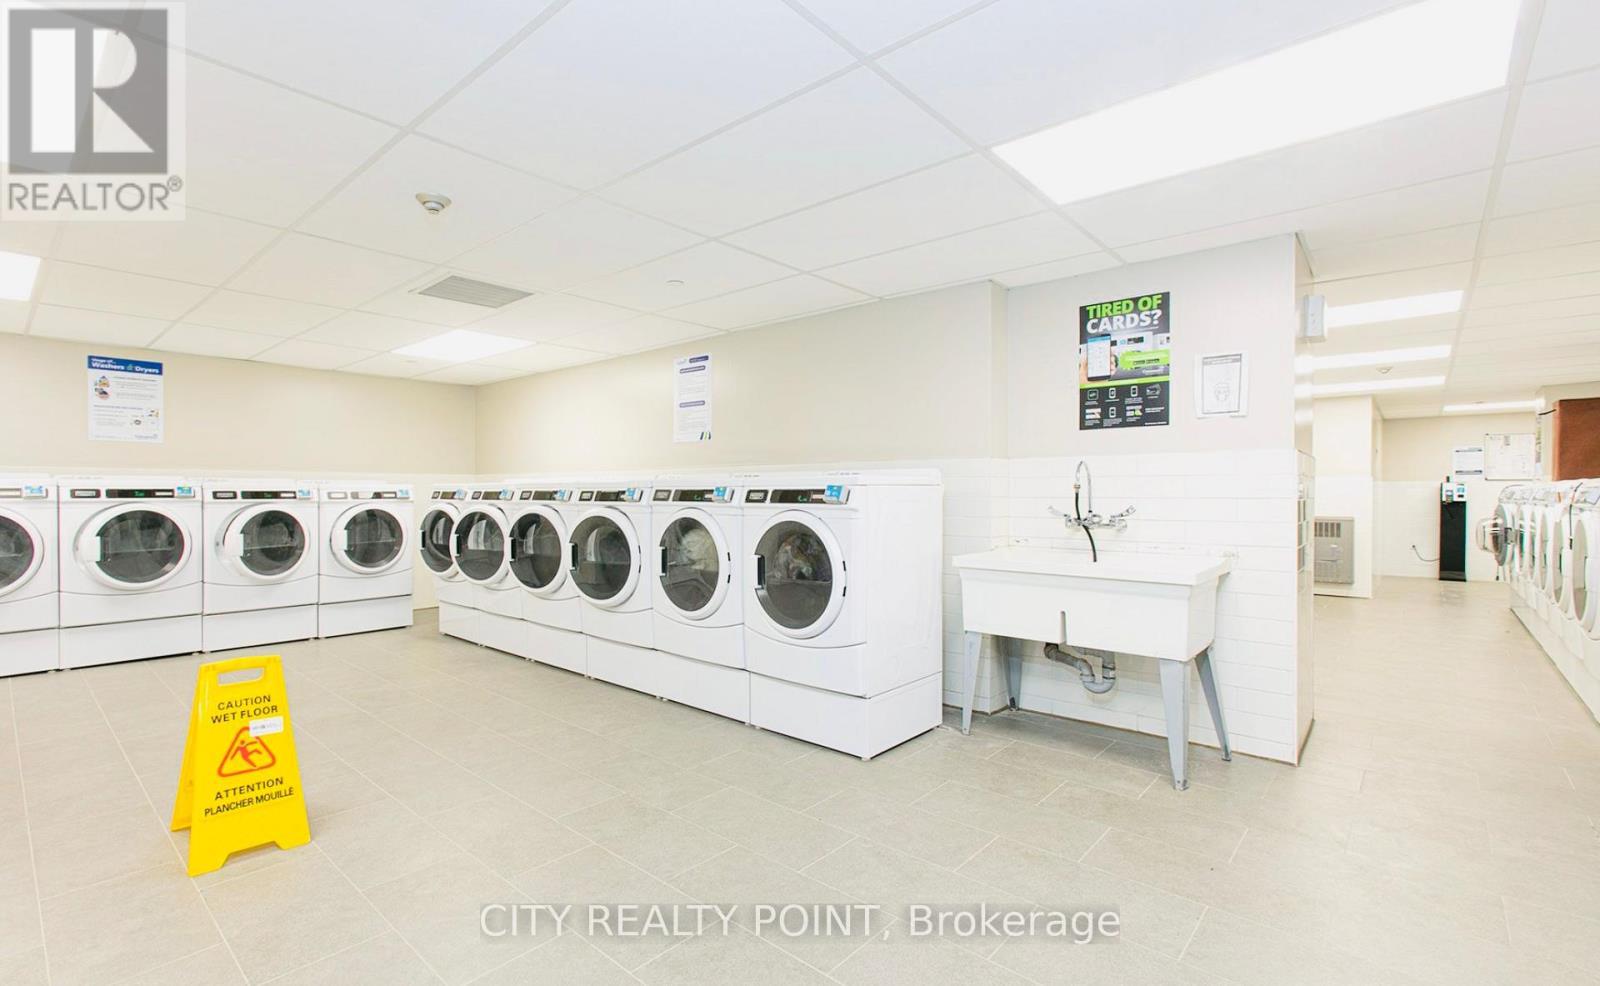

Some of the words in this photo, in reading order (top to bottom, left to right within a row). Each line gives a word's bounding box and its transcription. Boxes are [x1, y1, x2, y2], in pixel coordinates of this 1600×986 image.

[1086, 299, 1134, 319] TIRED
[1137, 294, 1162, 311] OF
[1086, 309, 1162, 334] CARDS?
[91, 361, 125, 371] Washers
[134, 366, 160, 374] Dryers
[217, 695, 271, 711] CAUTION
[211, 712, 237, 724] WET
[240, 705, 278, 719] FLOOR
[214, 777, 284, 801] ATTENTION
[204, 797, 254, 817] PLANCHER
